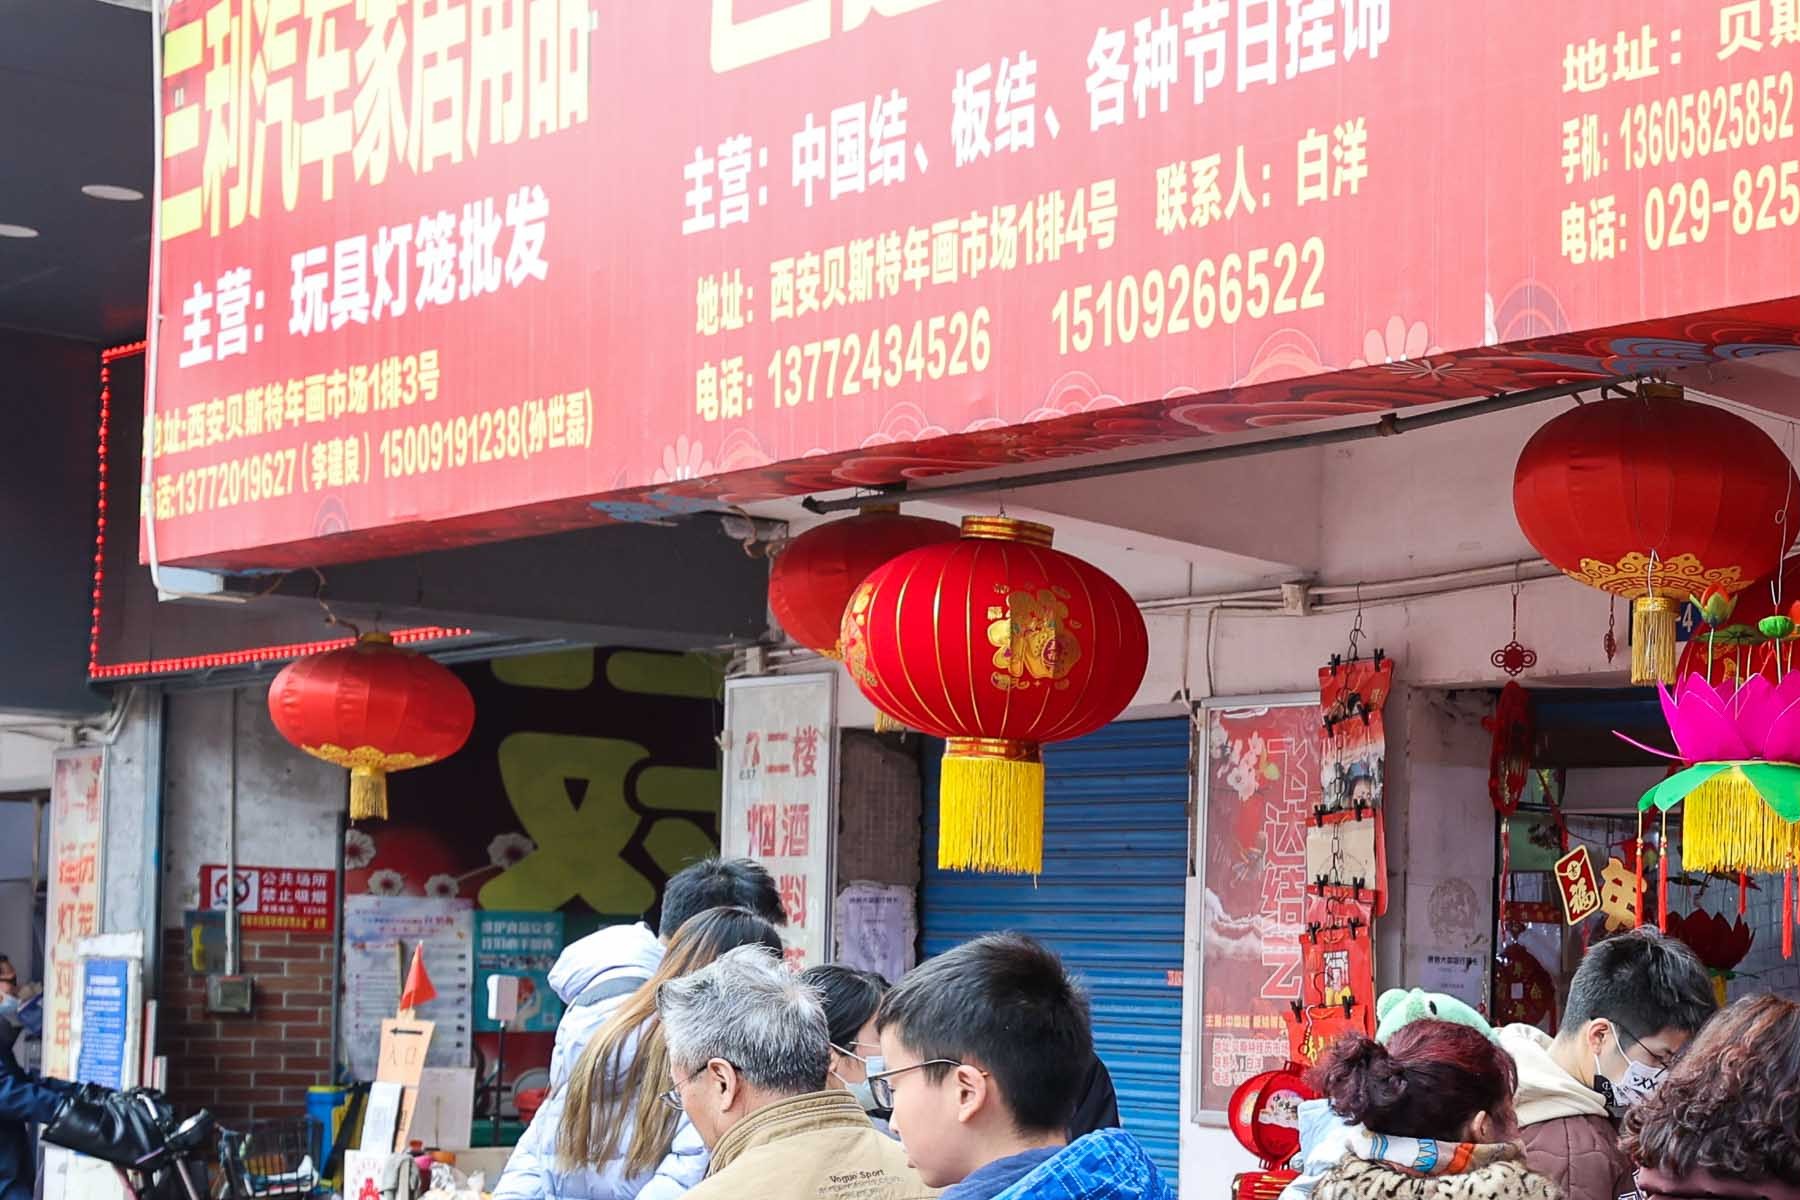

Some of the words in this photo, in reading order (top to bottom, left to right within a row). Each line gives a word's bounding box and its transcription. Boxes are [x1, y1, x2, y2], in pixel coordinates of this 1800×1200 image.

[1156, 117, 1369, 235] 联系人：白洋
[1052, 236, 1326, 356] 15109266522
[747, 803, 811, 857] 烟酒
